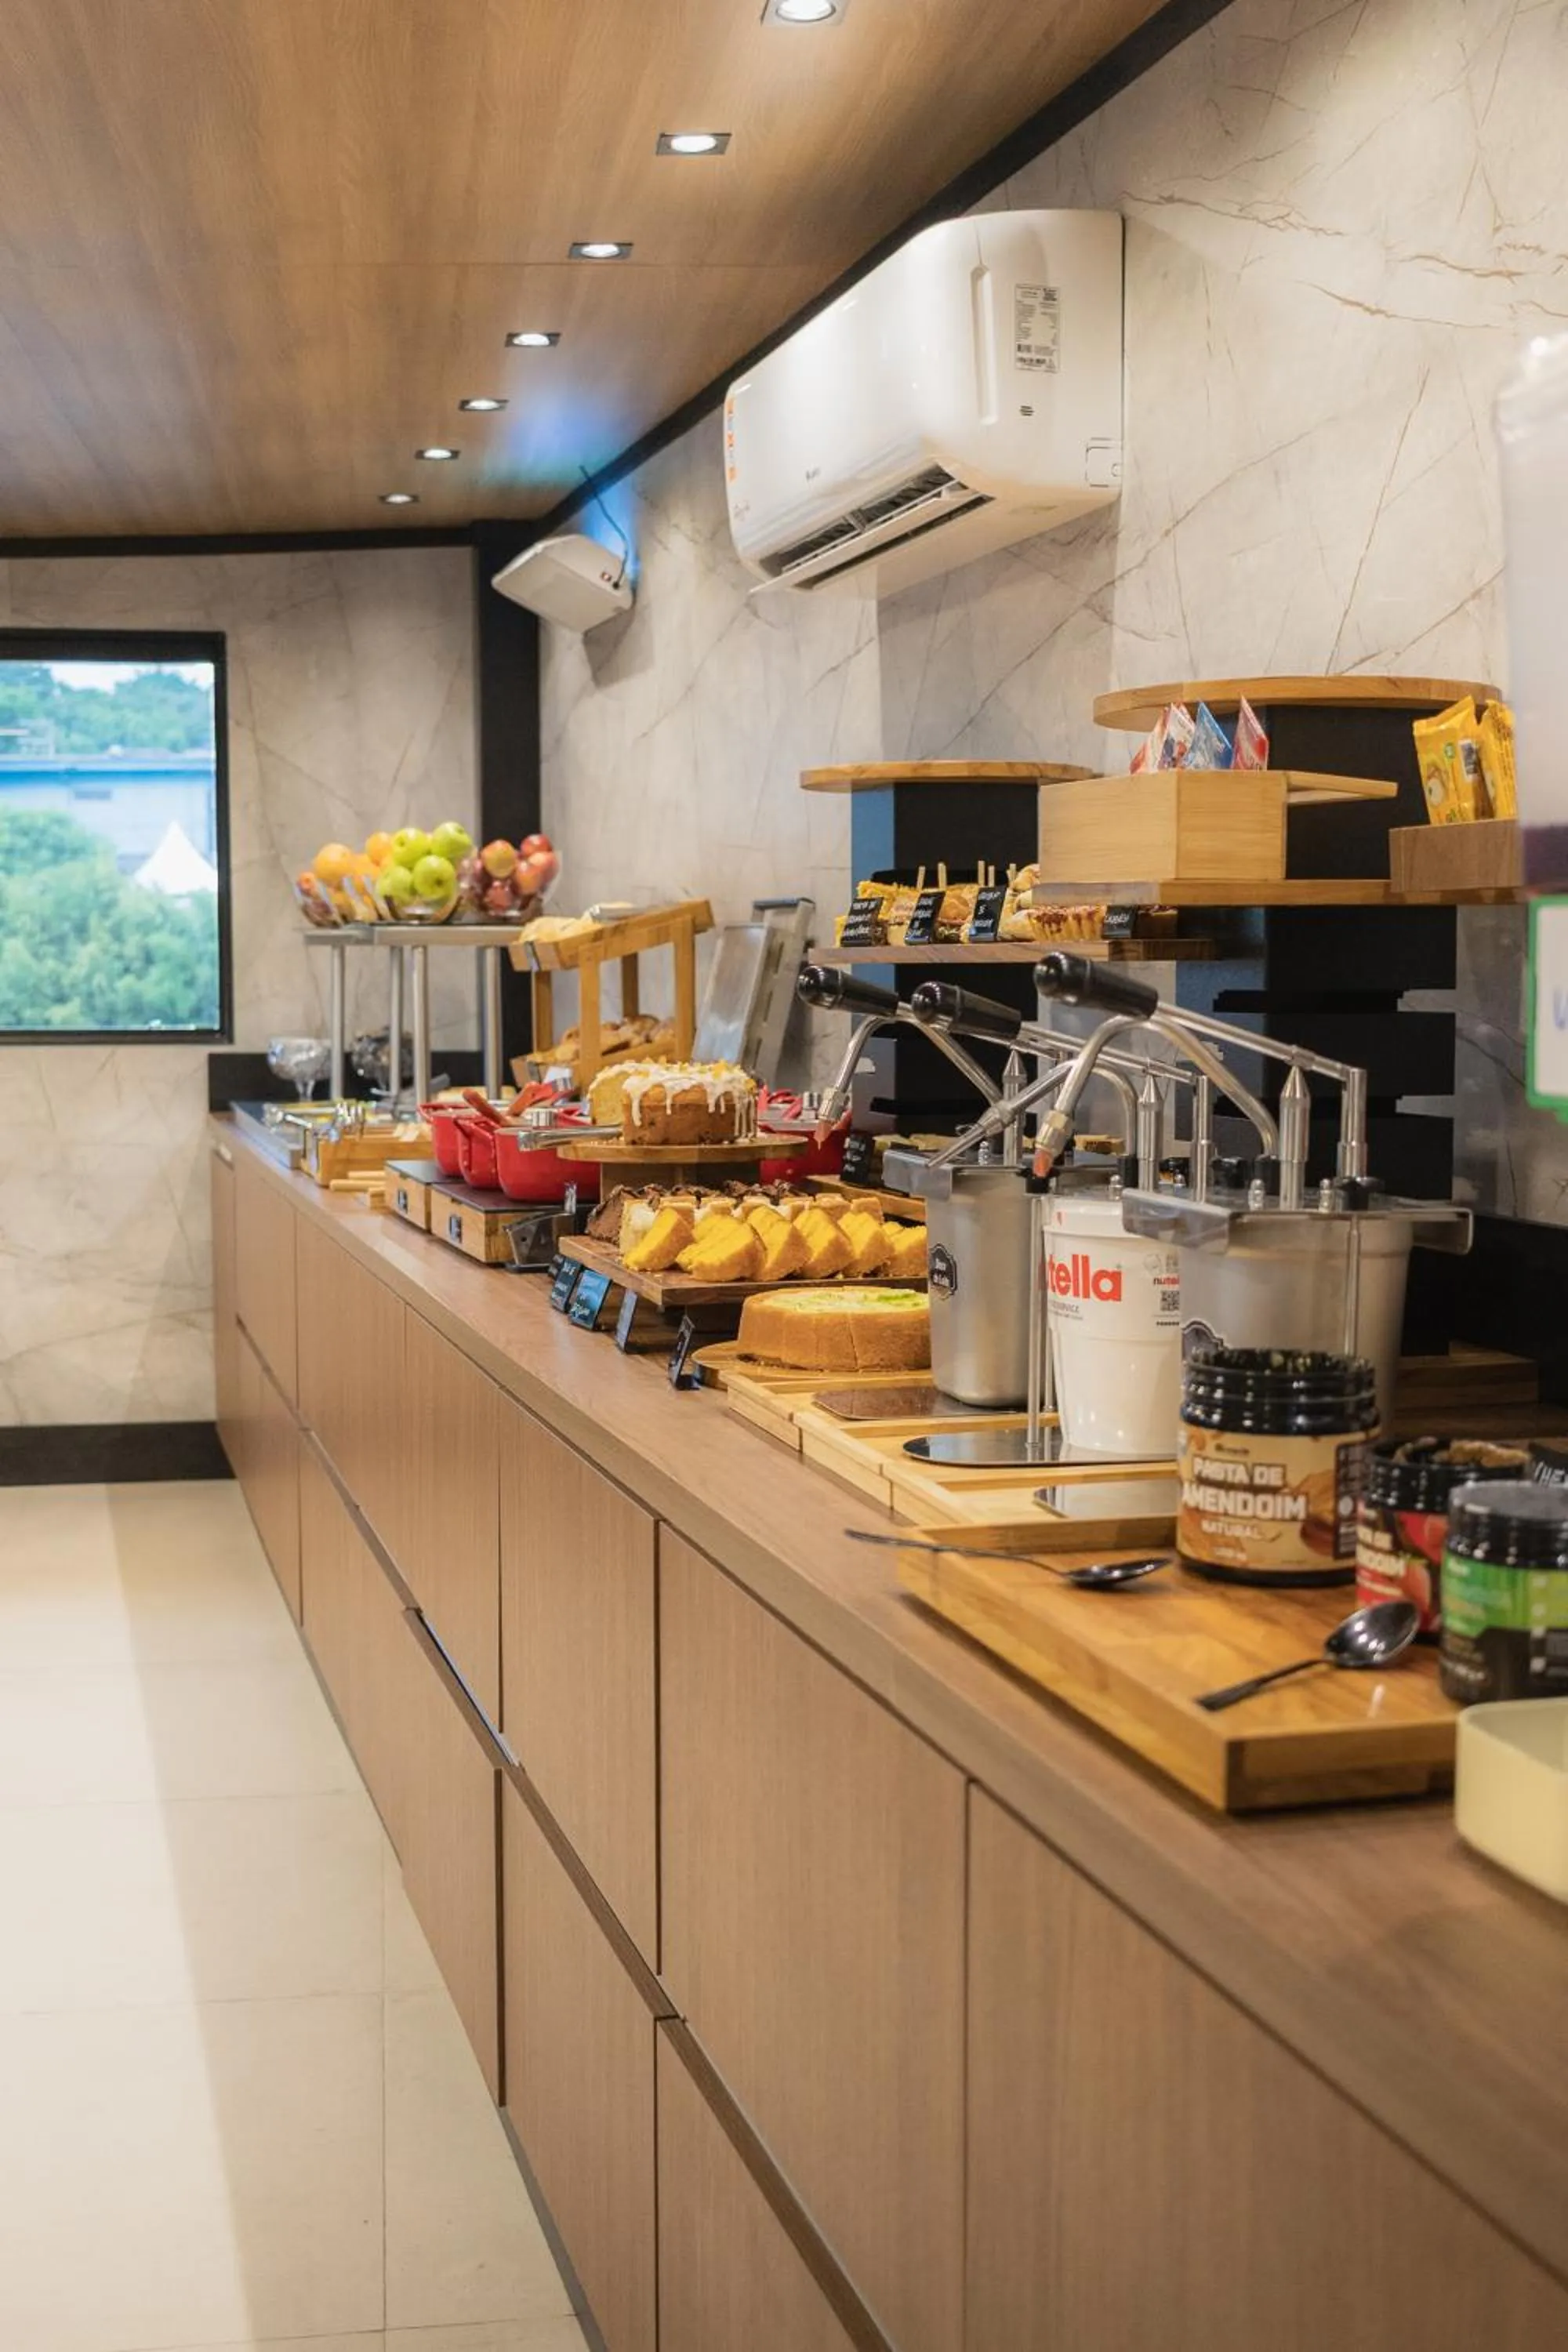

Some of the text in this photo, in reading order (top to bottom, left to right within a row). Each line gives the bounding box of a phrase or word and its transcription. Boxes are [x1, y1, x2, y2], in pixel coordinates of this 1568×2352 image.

[1193, 1457, 1284, 1486] PASTA DE
[1182, 1481, 1308, 1520] AMENDOIM
